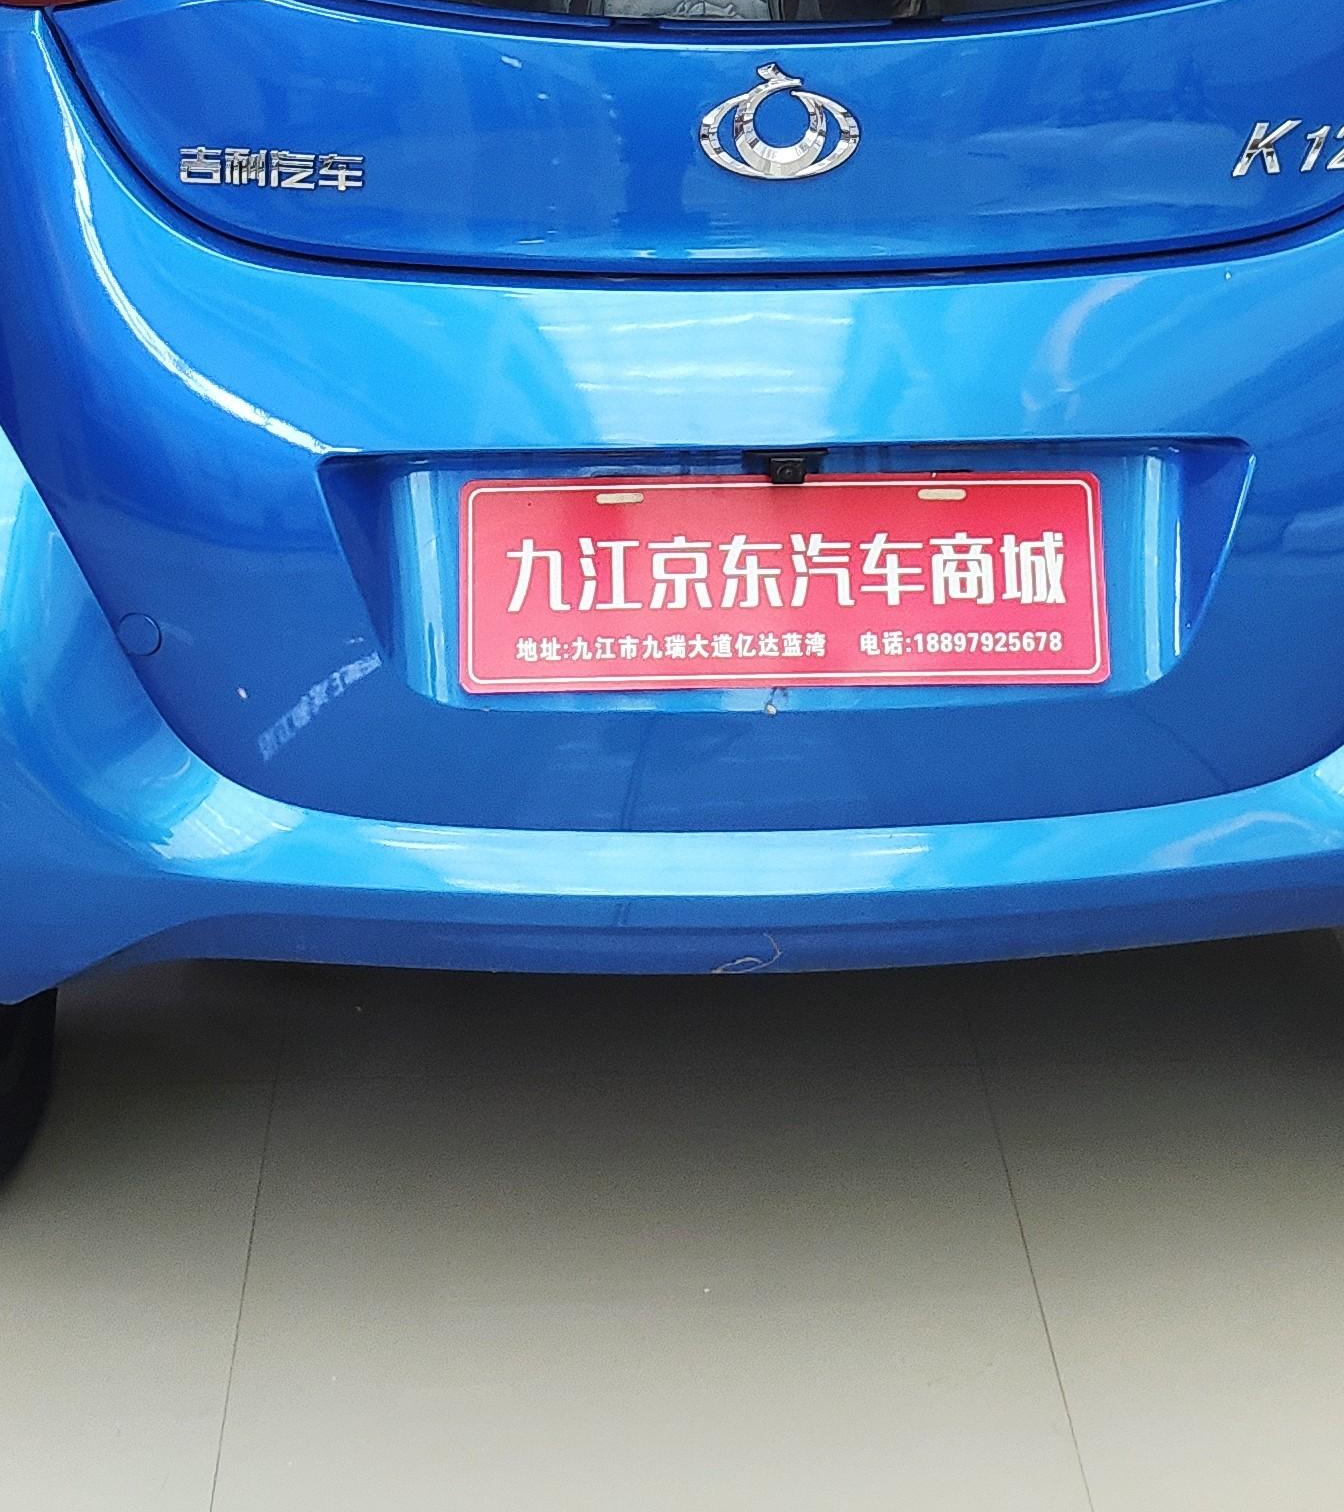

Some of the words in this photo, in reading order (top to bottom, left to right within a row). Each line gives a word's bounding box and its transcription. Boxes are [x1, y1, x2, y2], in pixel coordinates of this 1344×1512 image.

[506, 530, 1067, 613] 九江京东汽车商城
[515, 631, 827, 661] 地址:九江市九瑞大道亿达蓝湾
[859, 630, 1063, 656] 电话:18897925678
